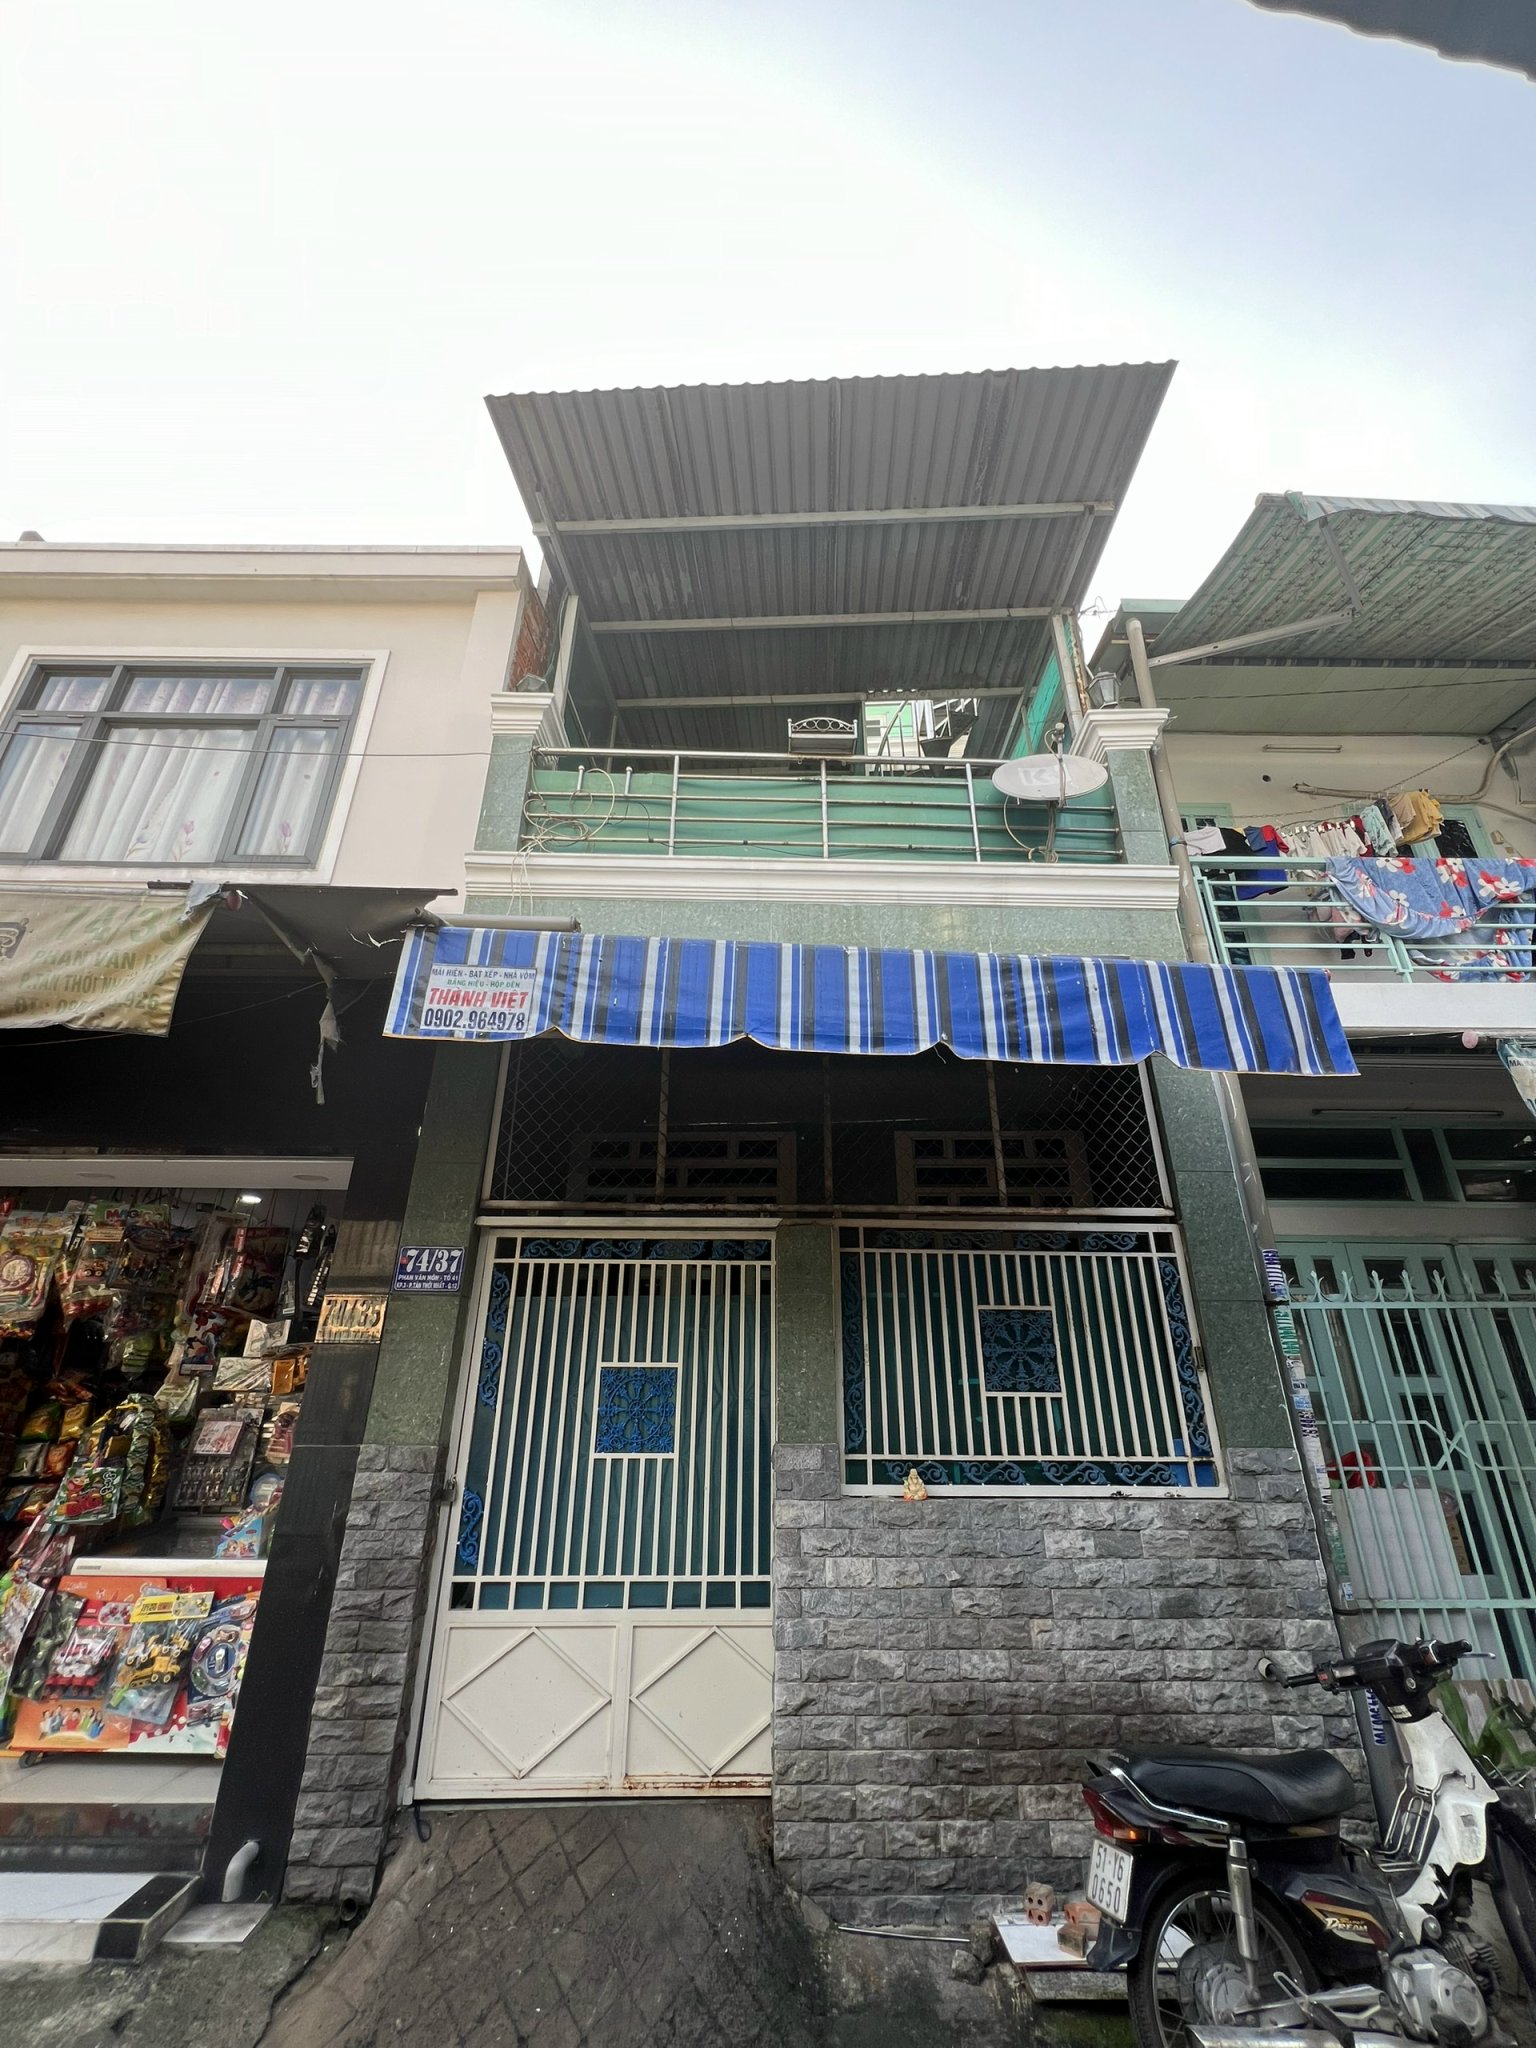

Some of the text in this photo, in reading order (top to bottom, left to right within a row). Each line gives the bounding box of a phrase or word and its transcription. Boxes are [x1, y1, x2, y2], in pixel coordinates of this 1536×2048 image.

[429, 986, 529, 1011] THÀNH VIỆT
[424, 1008, 526, 1031] 0902.964978
[406, 1249, 463, 1273] 74/37
[322, 1299, 381, 1327] 74/35
[1092, 1873, 1121, 1913] 0650
[1325, 1917, 1368, 1932] DREAM
